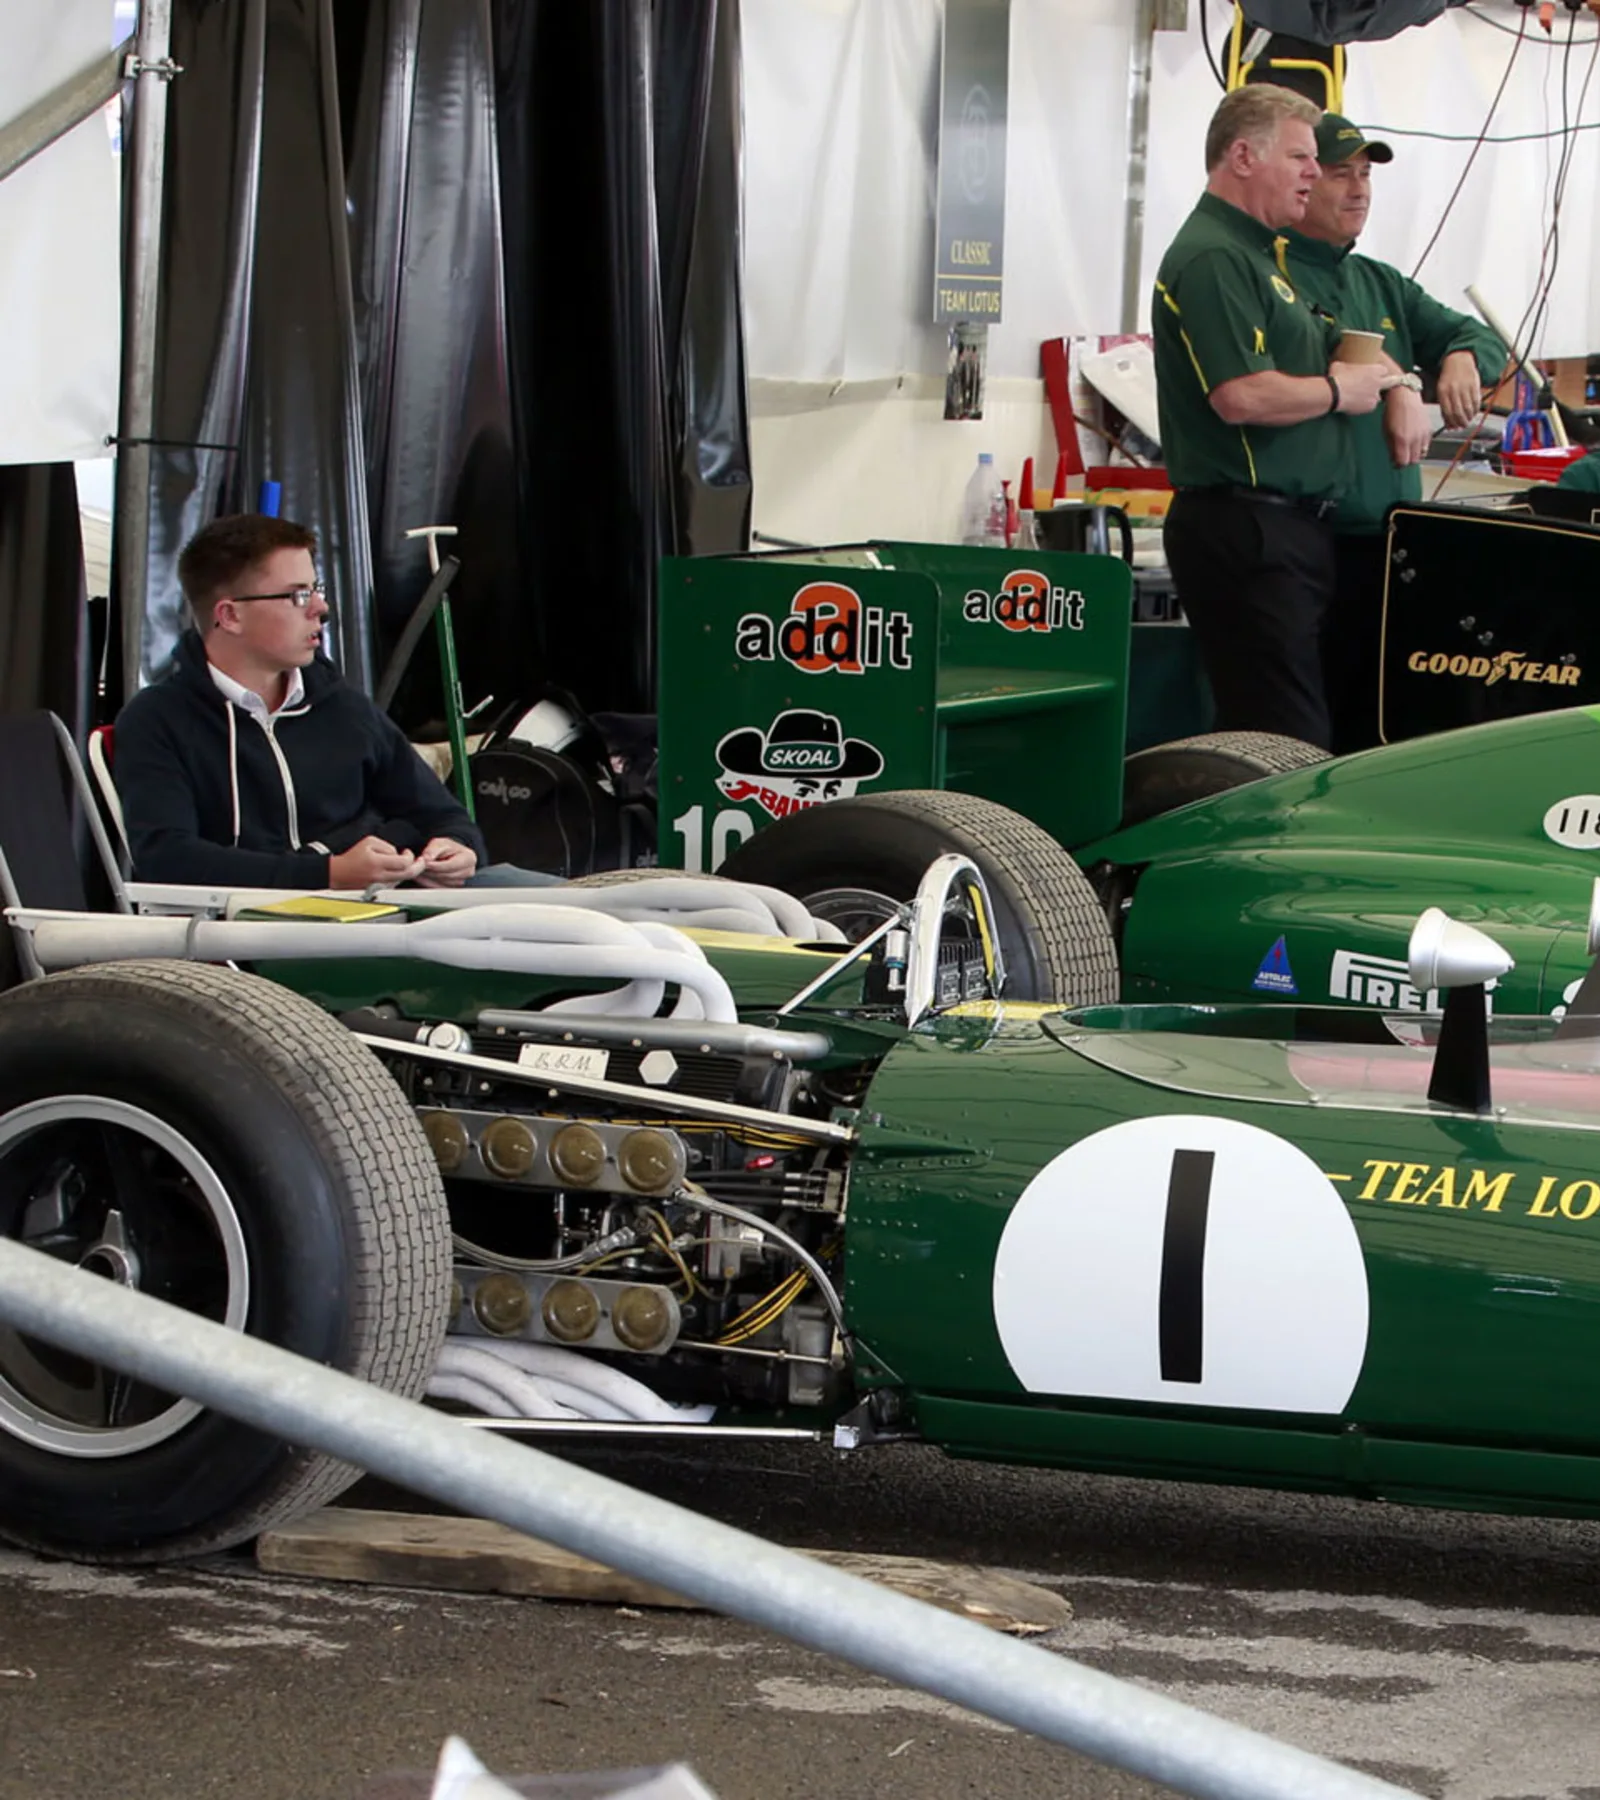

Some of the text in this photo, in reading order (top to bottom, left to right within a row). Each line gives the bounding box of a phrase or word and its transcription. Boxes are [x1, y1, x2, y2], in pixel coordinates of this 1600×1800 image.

[940, 289, 1000, 313] TEAM LOTUS
[963, 585, 1085, 629] addit
[736, 603, 913, 672] addit
[769, 749, 834, 767] SKOAL
[1329, 948, 1496, 1024] PIRELI
[1358, 1159, 1516, 1212] TEAM
[1158, 1148, 1216, 1385] 1
